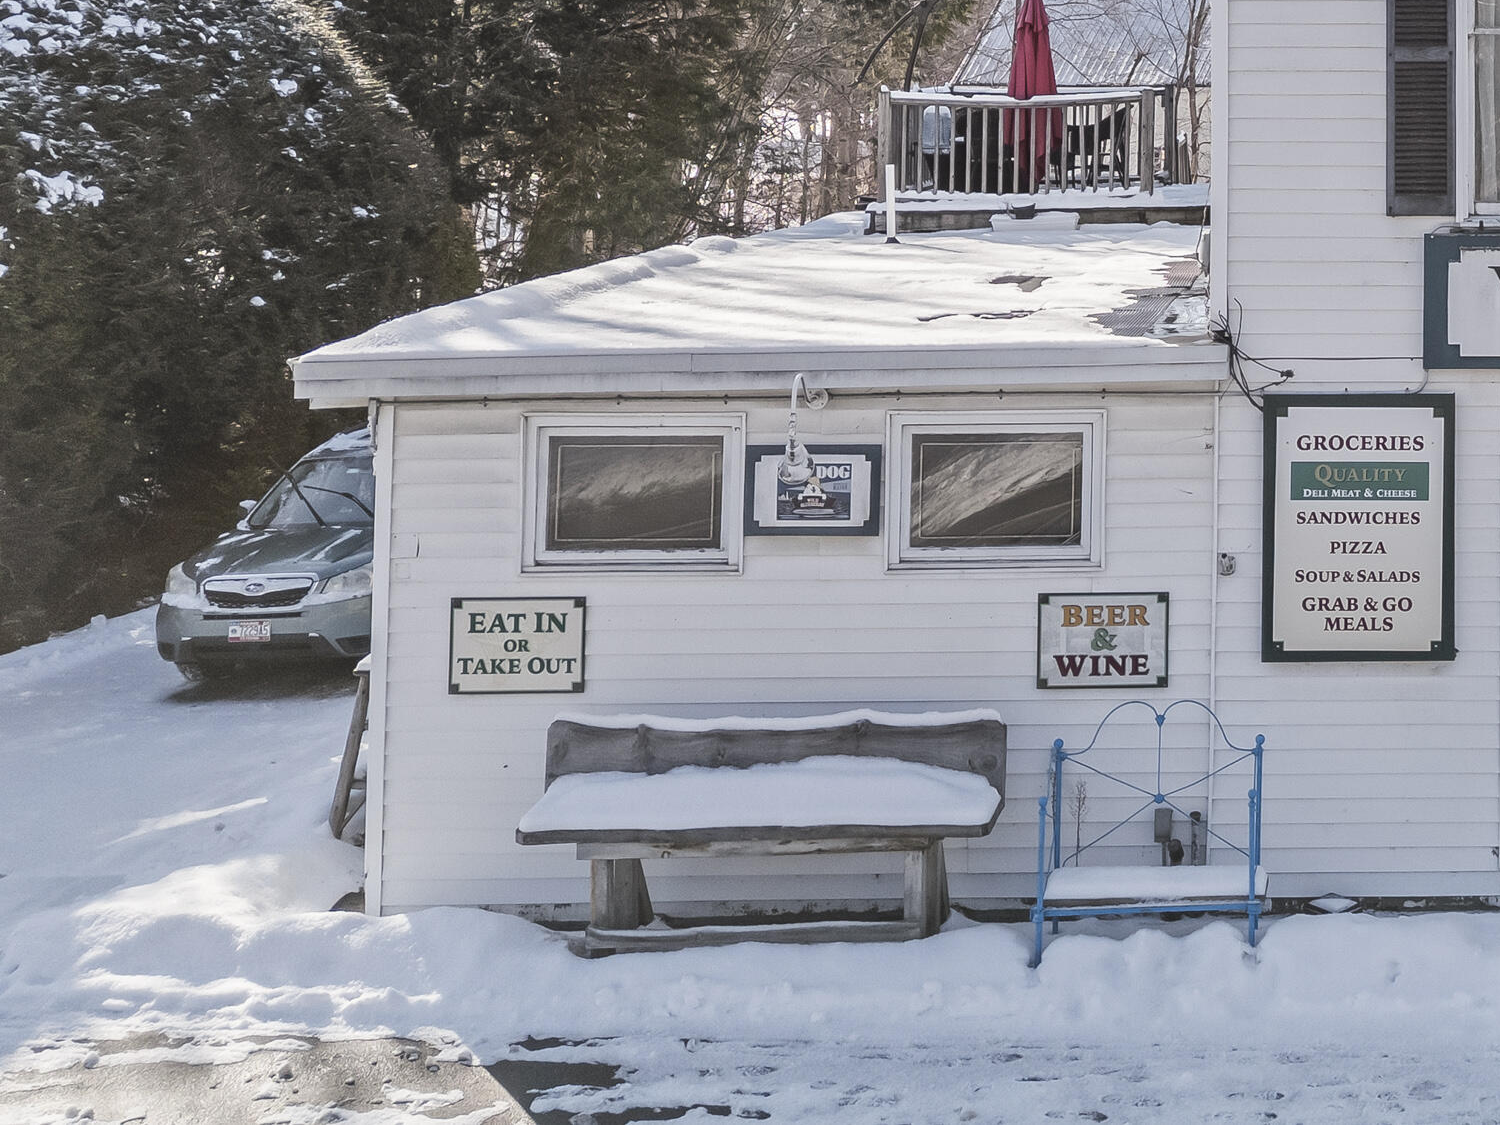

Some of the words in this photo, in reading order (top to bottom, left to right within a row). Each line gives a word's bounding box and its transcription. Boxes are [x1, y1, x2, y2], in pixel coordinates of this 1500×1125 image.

[1296, 435, 1425, 452] GROCERIES
[815, 465, 851, 479] DOG
[1314, 464, 1408, 487] QUALITY
[1303, 488, 1329, 498] DELI
[1331, 488, 1361, 498] MEAT
[1364, 488, 1374, 498] &
[1376, 488, 1417, 498] CHEESE
[1296, 511, 1421, 525] SANDWICHES
[1330, 541, 1387, 555] PIZZA
[1295, 569, 1341, 583] SOUP
[1343, 570, 1355, 582] &
[1357, 569, 1420, 583] SALADS
[1301, 597, 1359, 612] GRAB
[1364, 597, 1378, 612] &
[1382, 597, 1413, 612] GO
[468, 612, 526, 634] EAT
[533, 612, 568, 633] IN
[1061, 604, 1150, 627] BEER
[1324, 617, 1393, 632] MEALS
[503, 639, 530, 652] OR
[1091, 628, 1118, 651] &
[457, 658, 521, 675] TAKE
[527, 657, 577, 674] OUT
[1053, 654, 1150, 677] WINE
